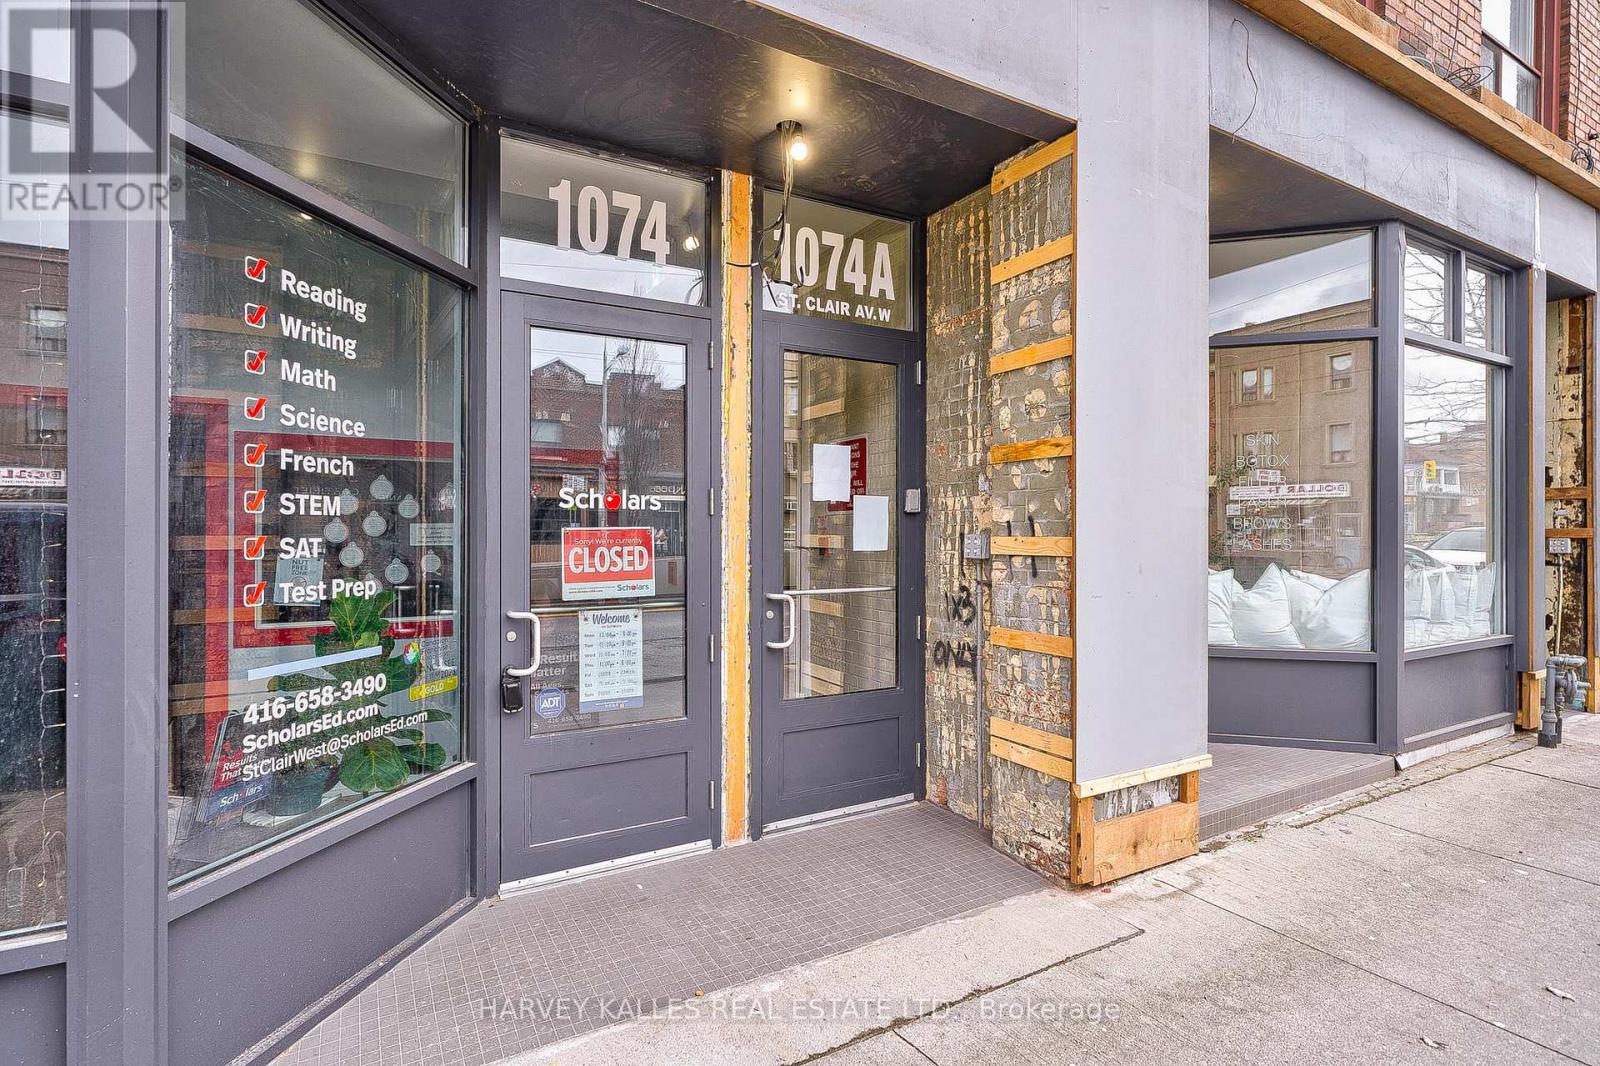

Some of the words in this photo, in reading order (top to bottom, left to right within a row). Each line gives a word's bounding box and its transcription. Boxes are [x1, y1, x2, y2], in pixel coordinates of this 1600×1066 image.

[548, 179, 670, 266] 1074
[773, 223, 895, 300] 1074A
[281, 268, 367, 323] Reading
[779, 292, 801, 309] ST.
[805, 296, 850, 316] CLAIR
[280, 313, 358, 360] Writing
[281, 358, 336, 392] Math
[280, 403, 366, 438] Science
[1246, 434, 1280, 447] SKIN
[280, 448, 354, 476] French
[1236, 454, 1290, 467] BOTOX
[279, 493, 341, 516] STEM
[1233, 517, 1292, 530] BROWS
[279, 537, 323, 560] SAT
[568, 545, 649, 574] CLOSED
[279, 580, 328, 604] Test
[331, 578, 377, 600] Prep
[592, 613, 631, 625] Welcome
[243, 673, 387, 725] 416-658-3490
[424, 682, 445, 694] GOLD
[541, 697, 561, 709] ADT
[243, 702, 379, 754] ScholarsEd.com
[243, 712, 428, 782] StClairWest@ScholarsEd.com
